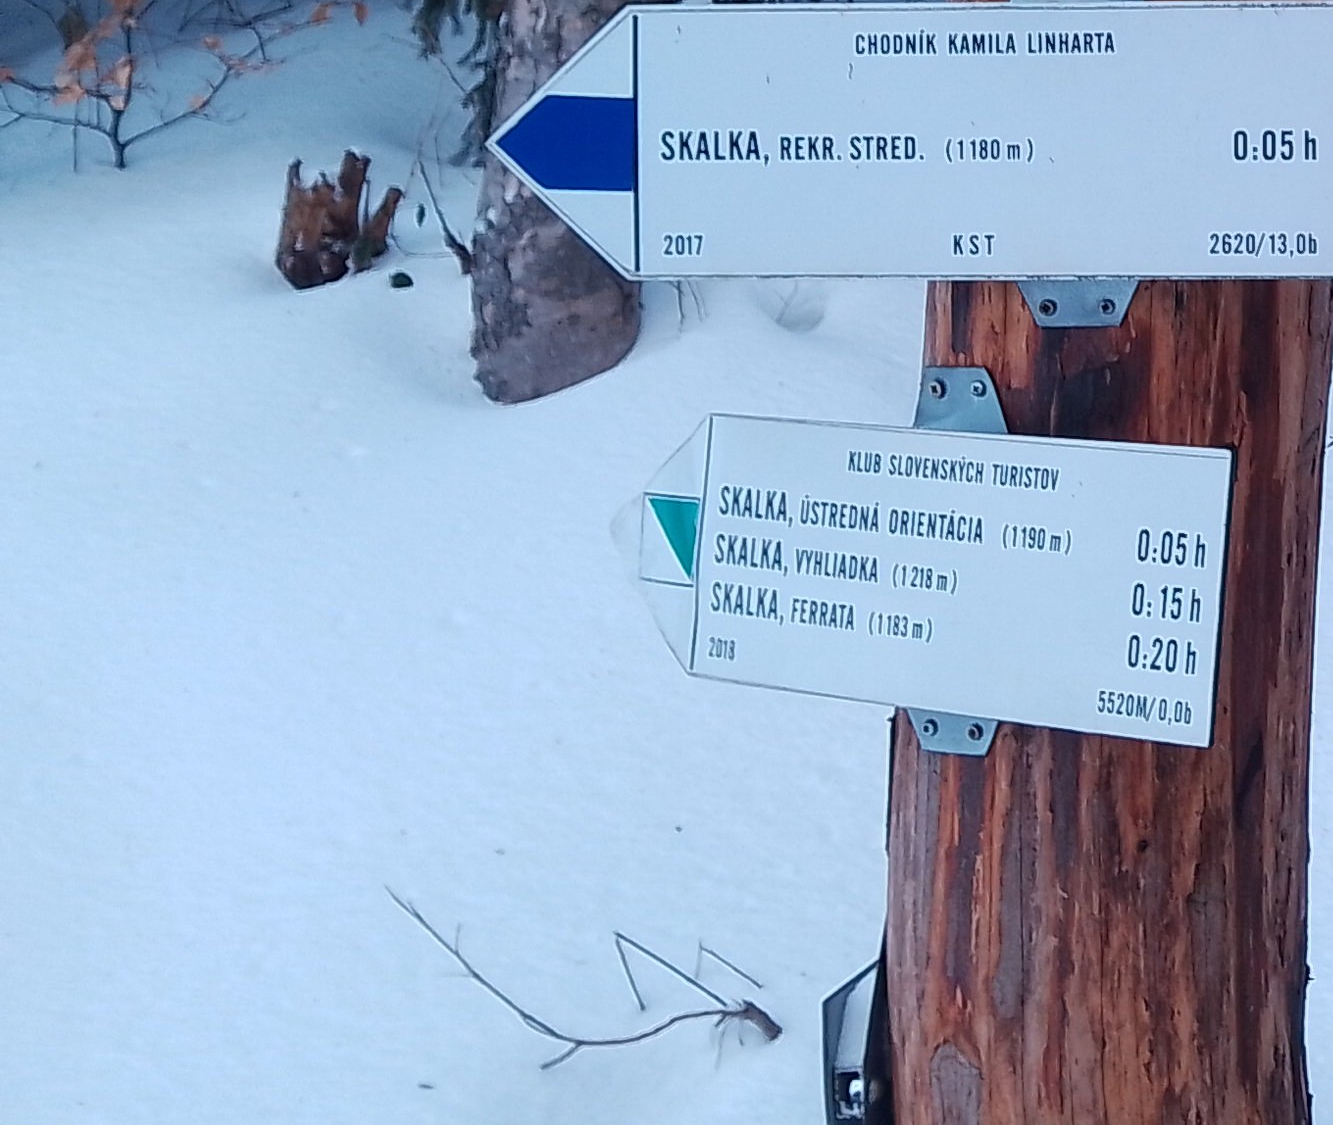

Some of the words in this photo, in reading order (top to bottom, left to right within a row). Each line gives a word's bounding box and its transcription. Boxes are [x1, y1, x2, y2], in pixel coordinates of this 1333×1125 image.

[855, 29, 937, 56] CHODNÍK
[948, 32, 1017, 55] KAMILA
[1027, 32, 1115, 54] LINHARTA
[660, 130, 770, 166] SKALKA,
[779, 135, 842, 161] REKR.
[849, 135, 925, 161] STRED.
[1233, 129, 1294, 161] 0:05
[1304, 129, 1317, 161] h
[663, 234, 704, 256] 2017
[952, 234, 995, 256] KST
[1209, 232, 1318, 258] 2620/13,0b
[847, 450, 882, 474] KLUB
[887, 454, 985, 484] SLOVENSKÝCH
[992, 463, 1060, 492] TURISTOV
[718, 485, 793, 528] SKALKA,
[799, 494, 880, 533] ÚSTREDNÁ
[888, 508, 983, 544] ORIENTÁCIA
[1137, 528, 1188, 566] 0:05
[1193, 533, 1206, 568] h
[714, 533, 788, 577] SKALKA,
[795, 548, 878, 583] VYHLIADKA
[1189, 588, 1201, 623] h
[710, 581, 784, 626] SKALKA,
[790, 597, 855, 631] FERRATA
[1127, 634, 1179, 673] 0:20
[1184, 641, 1197, 675] h
